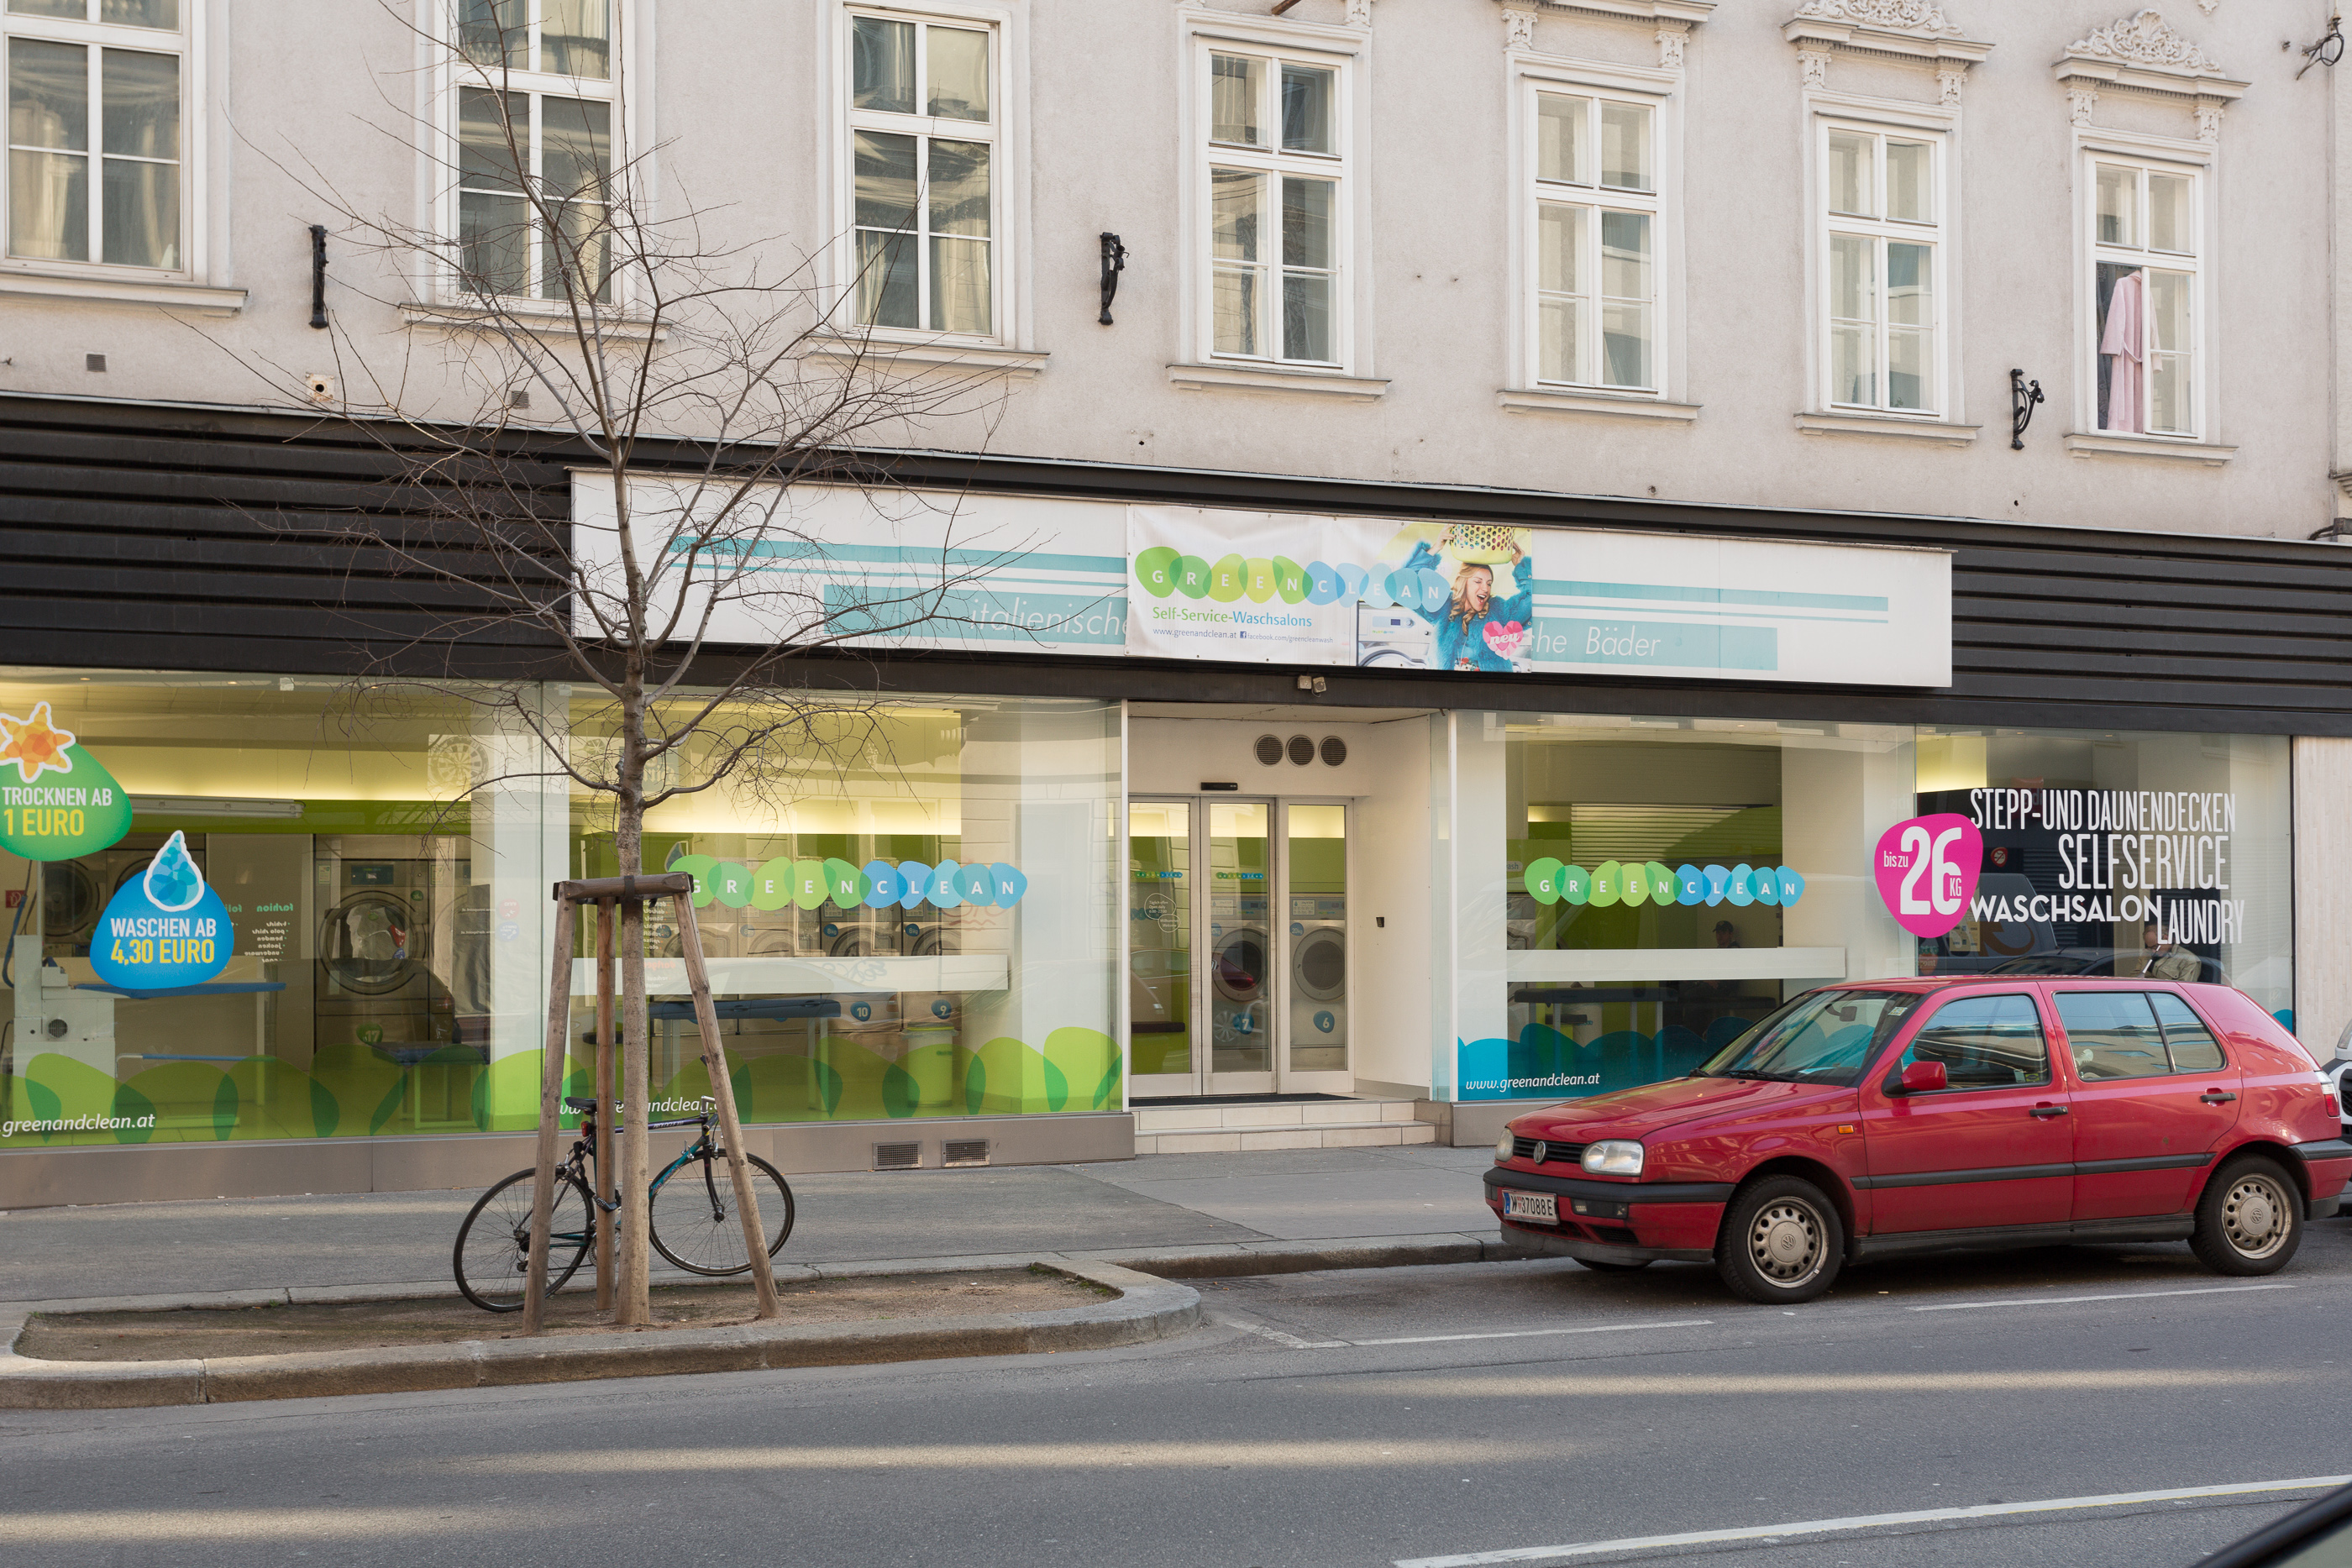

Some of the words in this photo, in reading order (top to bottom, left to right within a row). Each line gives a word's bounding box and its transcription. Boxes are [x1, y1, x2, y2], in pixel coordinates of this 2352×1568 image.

[1152, 606, 1312, 627] Self-Service-Waschsalons
[1152, 628, 1237, 642] www.greenandclean.at
[1488, 631, 1520, 646] neu
[1531, 621, 1567, 653] he
[1585, 624, 1662, 657] Bäder
[2, 787, 87, 806] TROCKNEN
[91, 788, 113, 806] AB
[2087, 790, 2236, 832] DAUNENDECKEN
[3, 808, 13, 836] 1
[23, 809, 85, 836] EURO
[1883, 850, 1898, 868] bis
[1898, 855, 1908, 868] zu
[2058, 833, 2229, 890] SELFSERVICE
[1900, 826, 1962, 915] 26
[1539, 878, 1795, 895] GREENCLEAN
[1950, 877, 1962, 897] KG
[1970, 894, 2161, 923] WASCHSALON
[110, 917, 191, 937] WASCHEN
[194, 918, 217, 937] AB
[2157, 899, 2245, 945] LAUNDRY
[111, 939, 154, 966] 4,30
[160, 939, 215, 964] EURO
[856, 1007, 869, 1017] 10
[940, 1005, 947, 1015] 9
[1242, 1018, 1249, 1030] 7
[1322, 1017, 1330, 1029] 6
[1465, 1072, 1600, 1093] www.greenandclean.at
[1510, 1195, 1517, 1212] W
